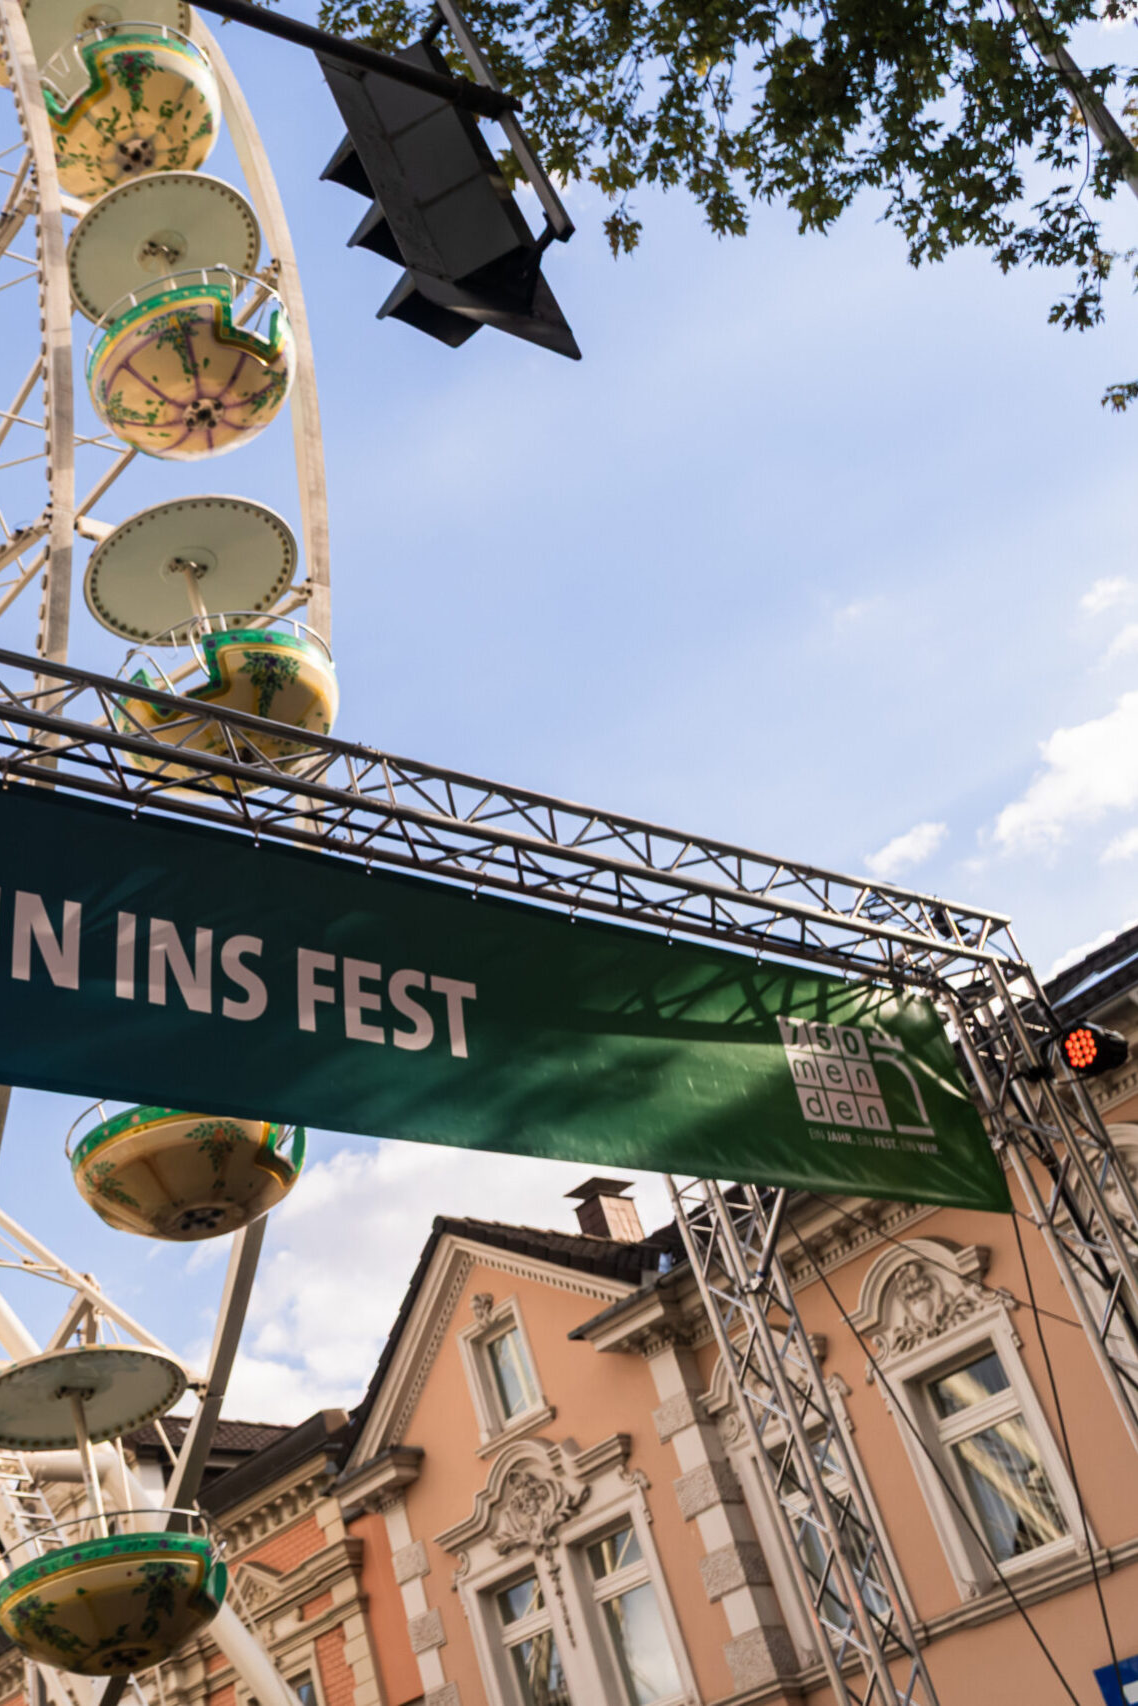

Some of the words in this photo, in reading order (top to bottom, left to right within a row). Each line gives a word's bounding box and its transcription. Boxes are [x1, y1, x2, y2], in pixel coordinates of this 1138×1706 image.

[115, 910, 268, 1022] INS
[298, 947, 477, 1059] FEST
[793, 1058, 871, 1088] men
[806, 1092, 883, 1126] den
